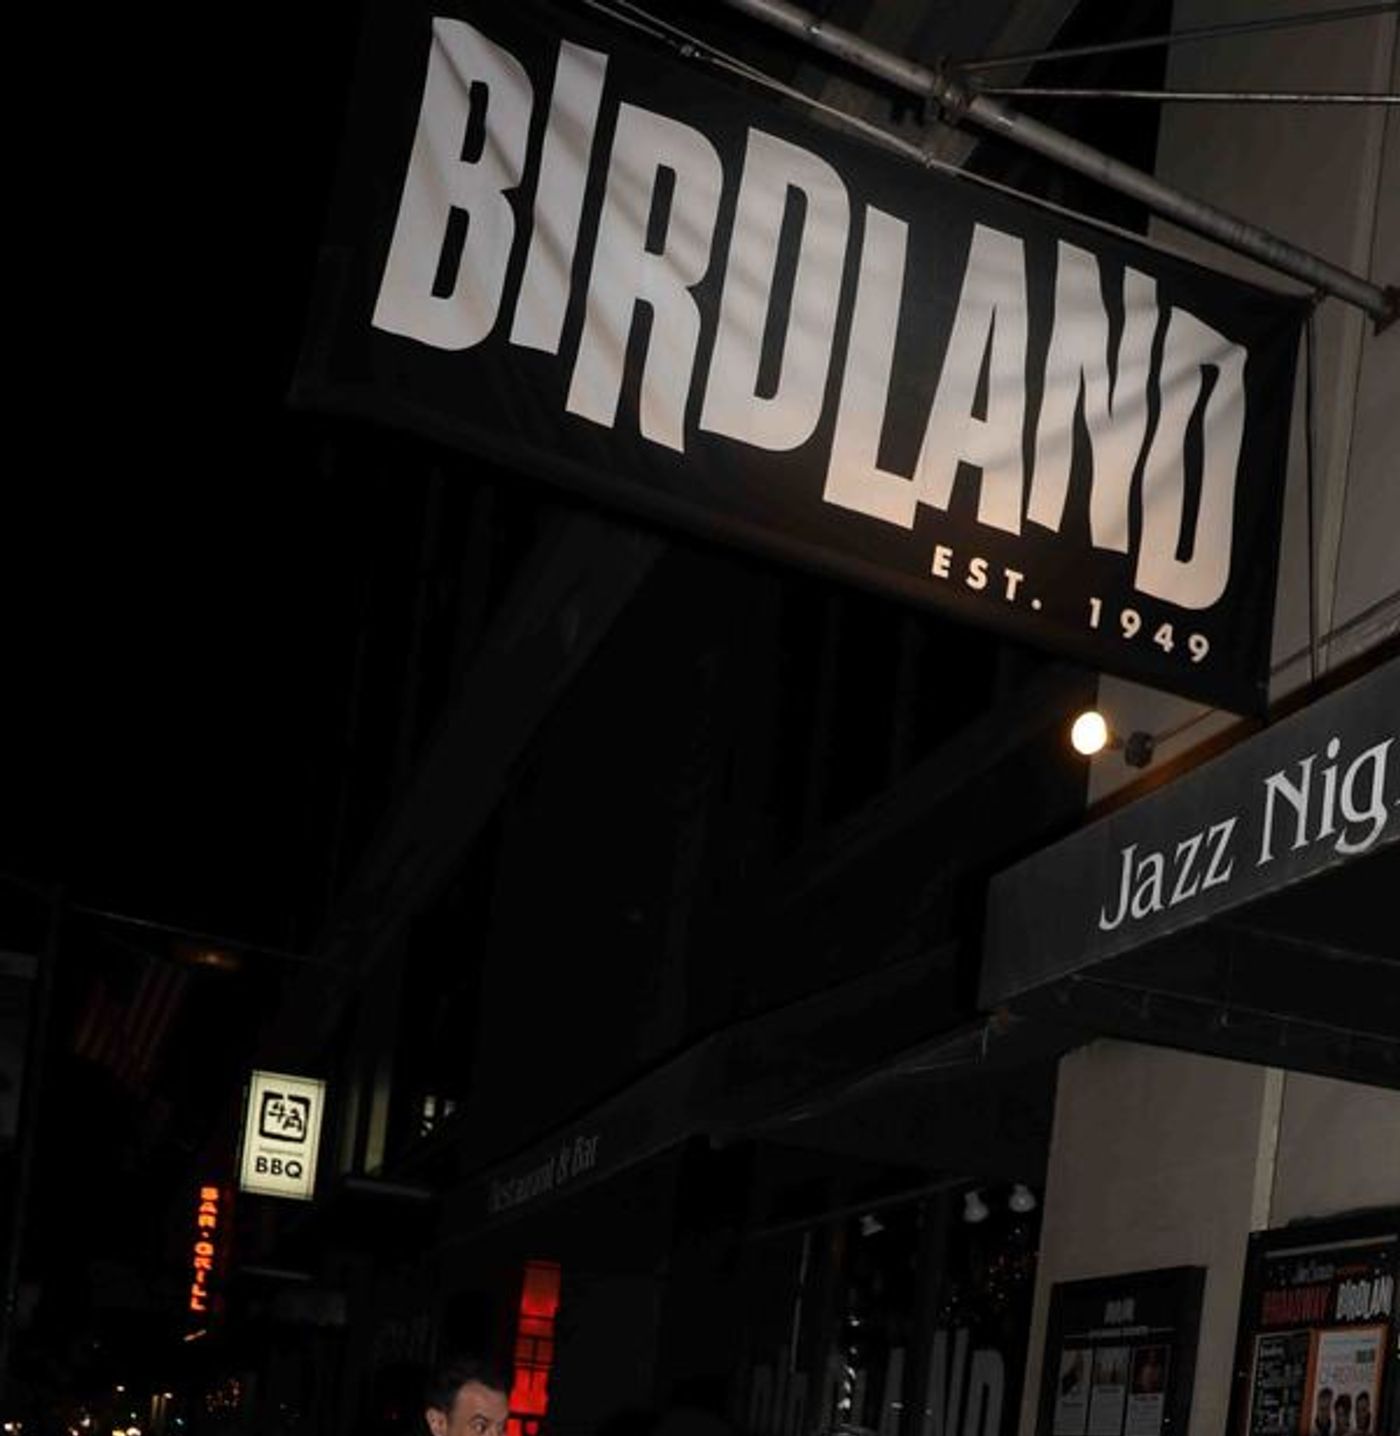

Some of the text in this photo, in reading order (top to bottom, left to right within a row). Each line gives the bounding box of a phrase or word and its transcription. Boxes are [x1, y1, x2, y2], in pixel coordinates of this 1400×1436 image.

[370, 15, 1249, 611] BIRDLAND
[930, 544, 1211, 663] EST. 1949
[1098, 735, 1400, 931] Jazz Nig
[255, 1155, 303, 1179] BBQ
